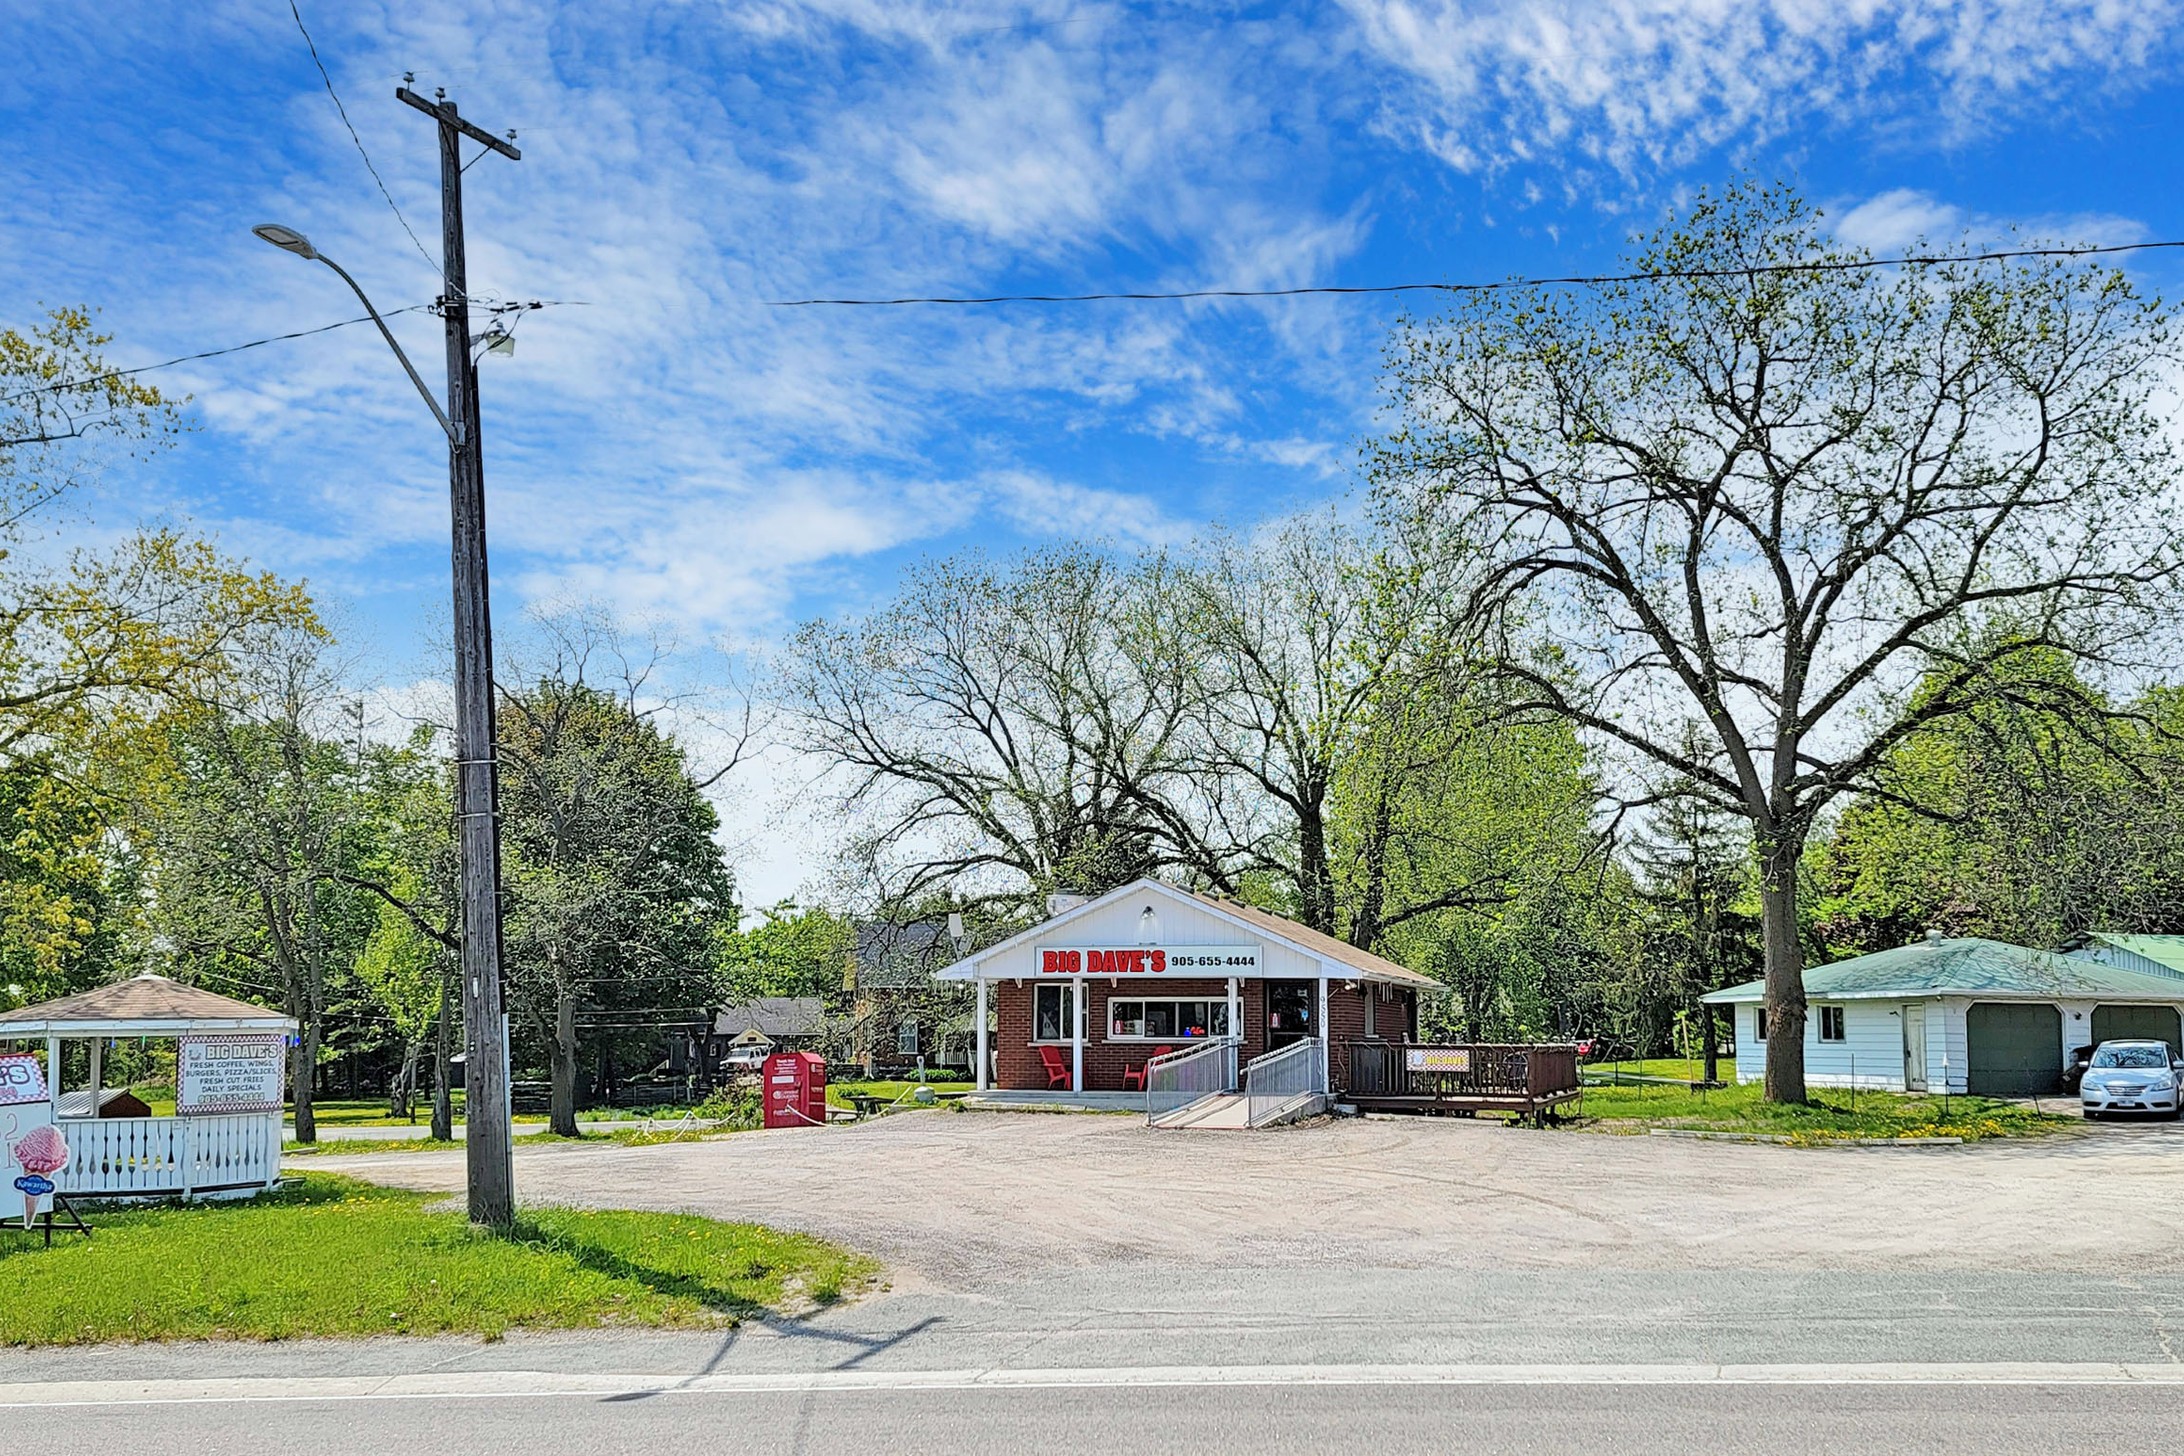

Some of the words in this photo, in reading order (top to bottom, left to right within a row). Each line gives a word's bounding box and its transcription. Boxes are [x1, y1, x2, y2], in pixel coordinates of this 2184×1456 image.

[1042, 951, 1080, 972] BIG
[1087, 950, 1166, 972] DAVE'S
[1171, 956, 1255, 966] 905-655-4444
[206, 1045, 229, 1059] BIG
[231, 1044, 278, 1058] DAVE'S
